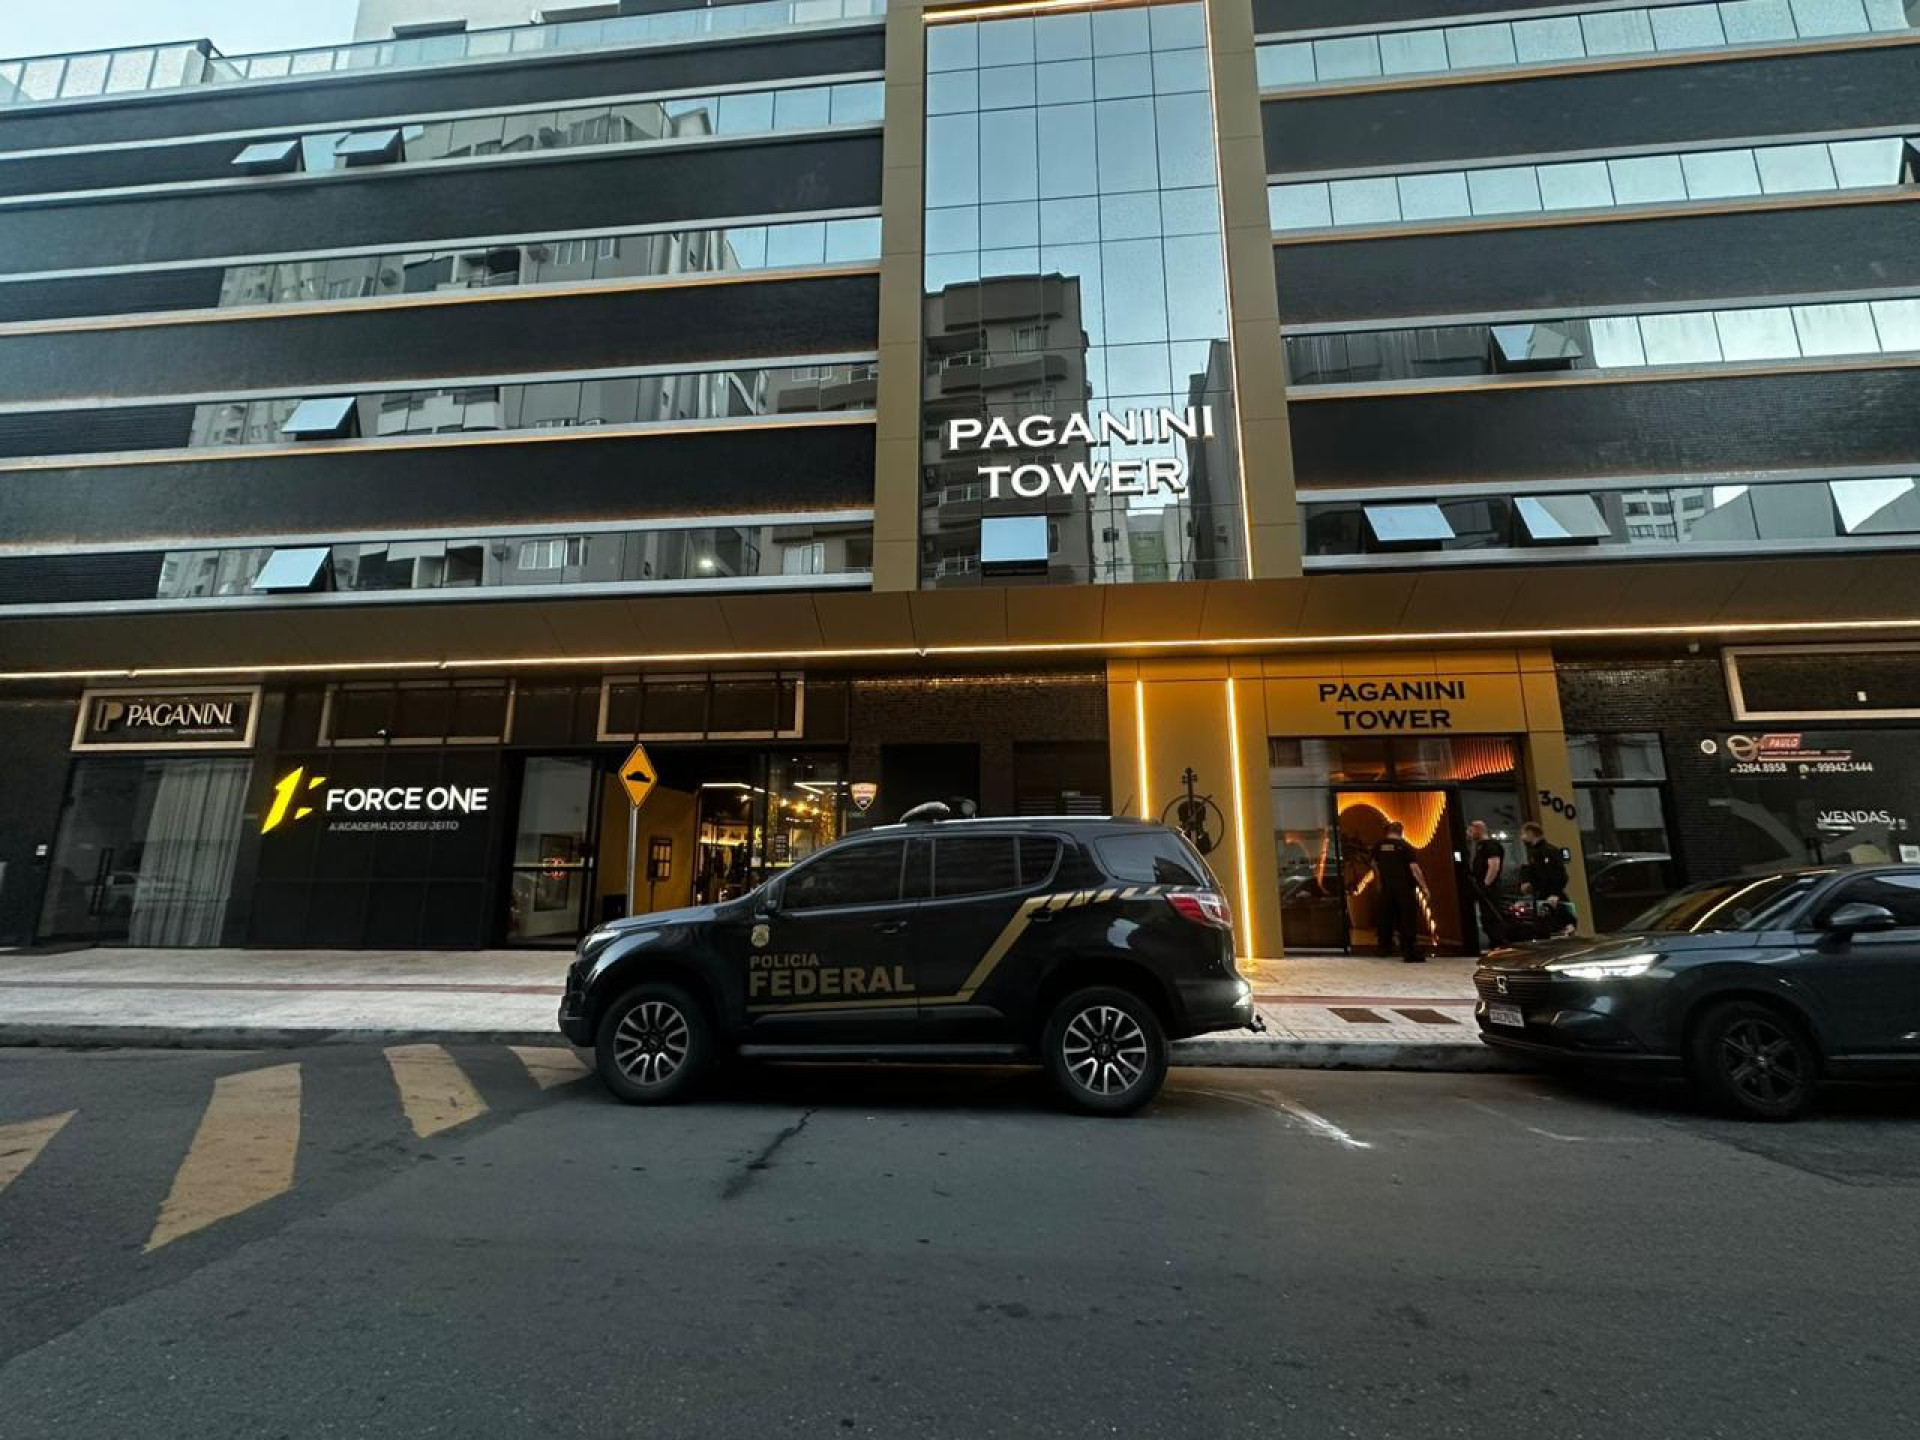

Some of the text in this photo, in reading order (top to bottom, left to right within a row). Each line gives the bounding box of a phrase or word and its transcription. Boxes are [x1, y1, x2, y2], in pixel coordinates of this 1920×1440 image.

[948, 405, 1215, 450] PAGANINI
[977, 457, 1187, 498] TOWER
[1319, 680, 1465, 702] PAGANINI
[126, 703, 234, 727] PAGANINI
[1336, 708, 1452, 730] TOWER
[326, 784, 489, 813] FORCE ONE
[1538, 790, 1576, 820] 300
[337, 821, 388, 832] ACADEMIA
[390, 821, 406, 831] DO
[407, 821, 427, 831] SEU
[429, 820, 459, 831] JEITO
[751, 965, 916, 997] FEDERAL
